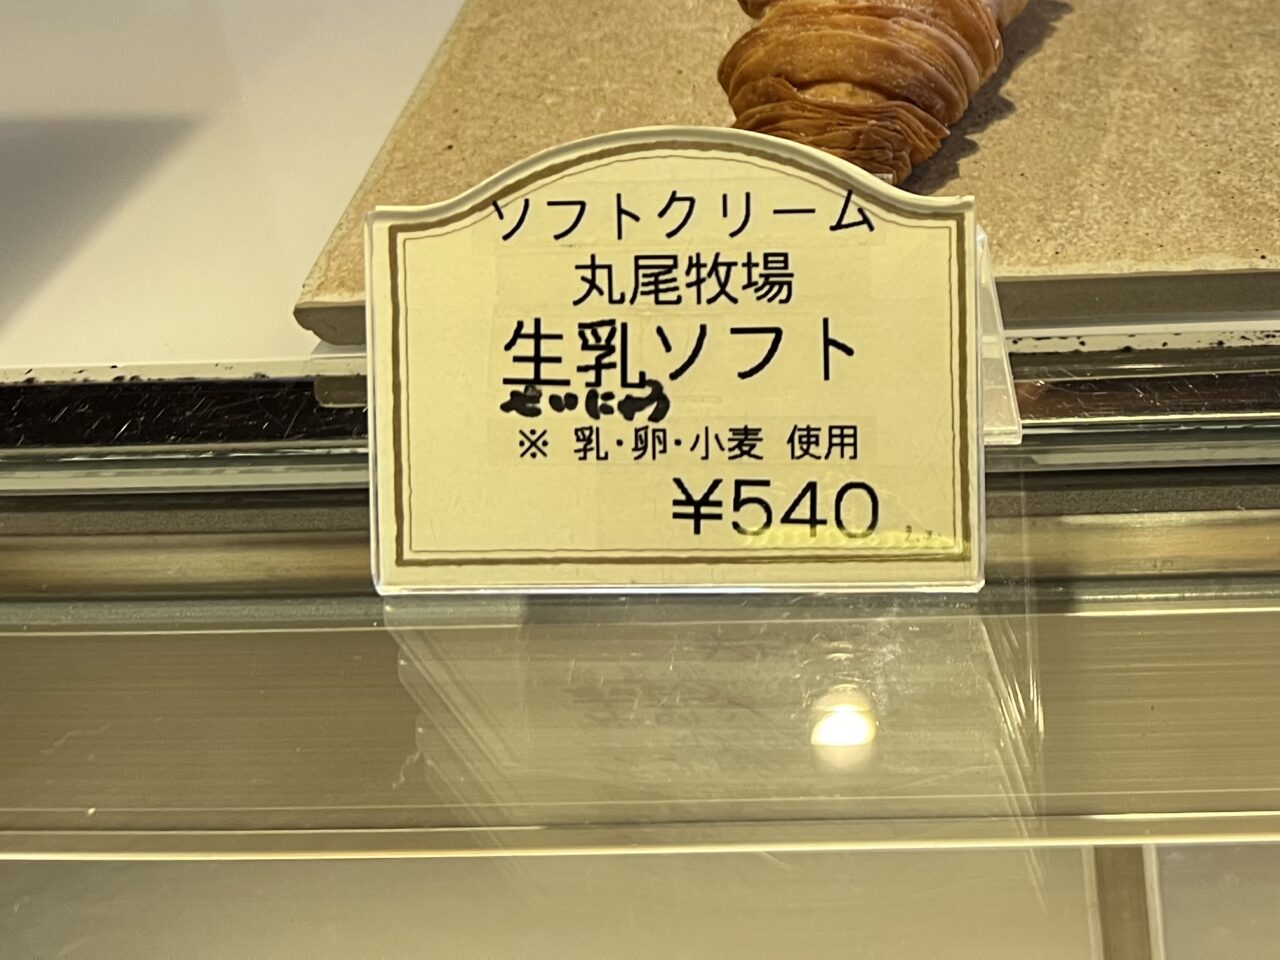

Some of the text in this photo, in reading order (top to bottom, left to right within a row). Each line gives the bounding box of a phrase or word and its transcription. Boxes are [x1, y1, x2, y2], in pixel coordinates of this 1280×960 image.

[492, 189, 877, 241] ソフトクリーム
[571, 251, 796, 306] 丸尾牧場
[502, 317, 856, 389] 生乳ソフト
[786, 424, 859, 461] 使用
[672, 477, 881, 539] ¥540
